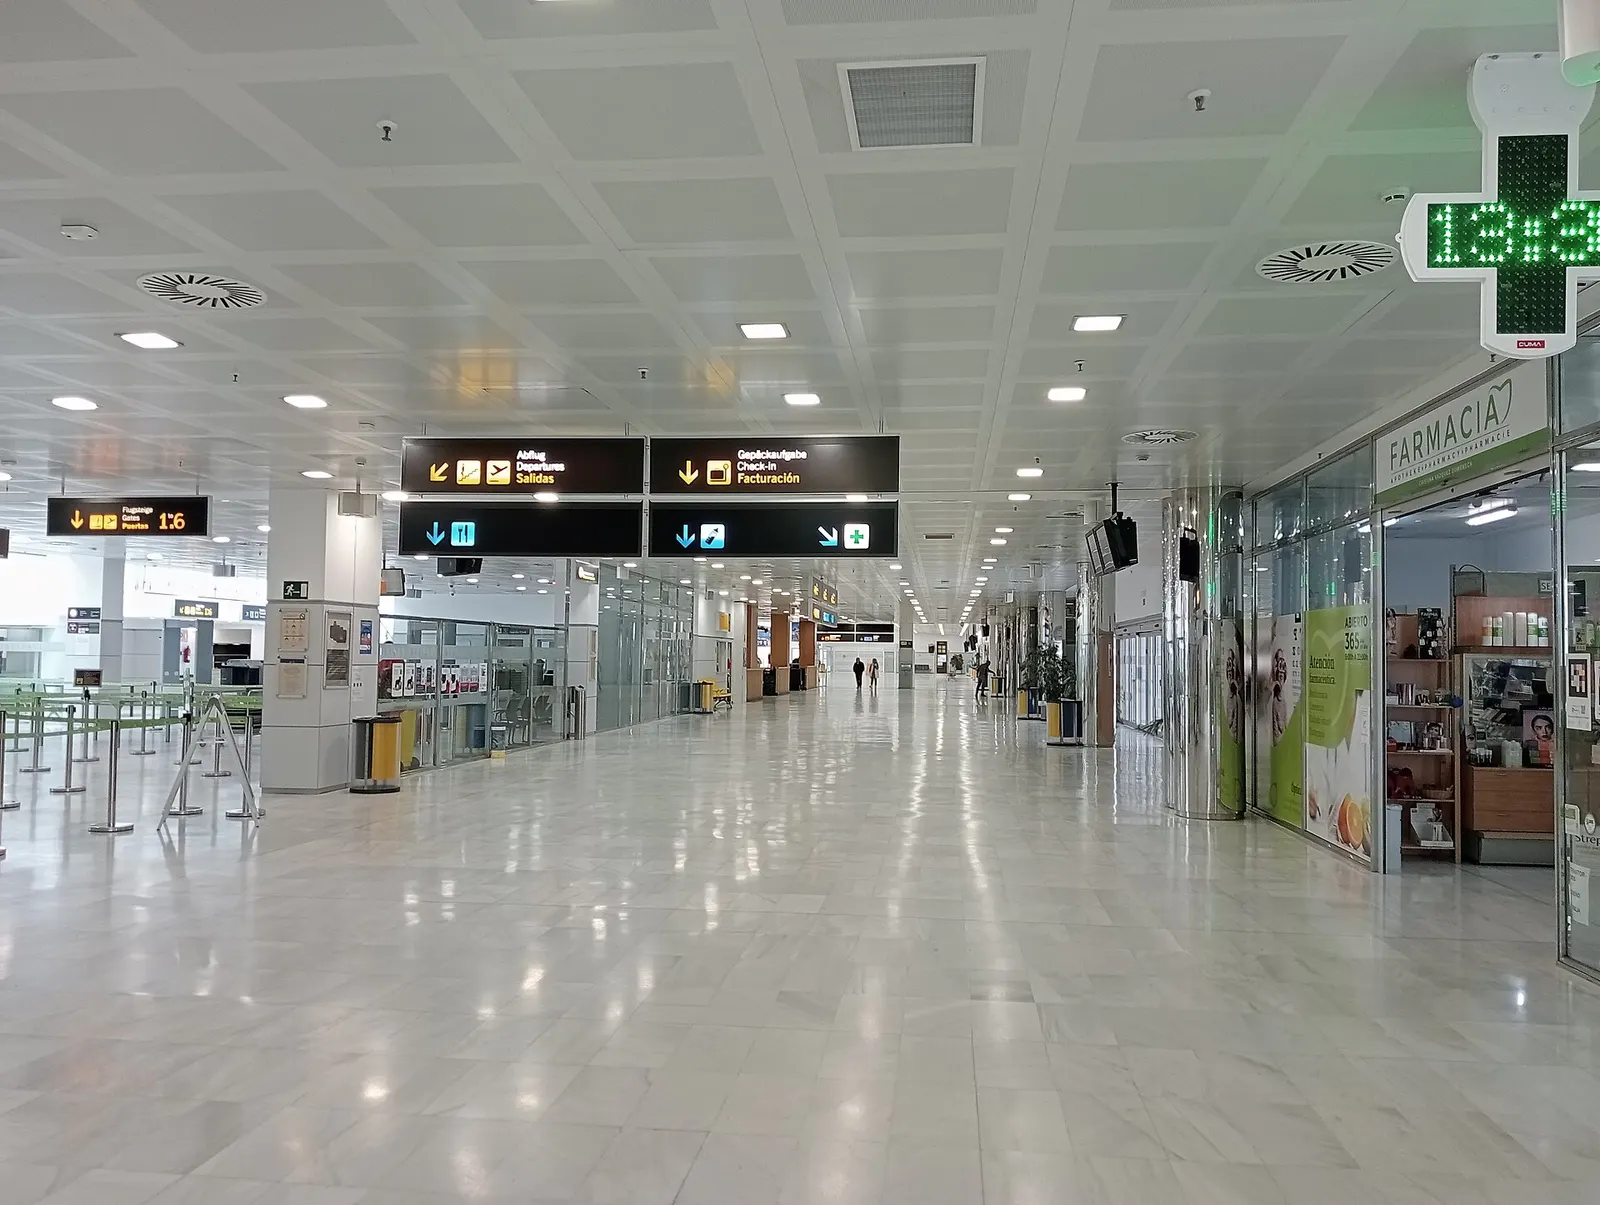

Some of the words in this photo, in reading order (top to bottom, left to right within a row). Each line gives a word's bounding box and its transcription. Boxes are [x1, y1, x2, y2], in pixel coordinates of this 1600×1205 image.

[1390, 394, 1500, 471] FARMACIA
[516, 450, 547, 462] Abflug
[737, 449, 807, 461] Gepäckaufgabe
[516, 462, 565, 473] Departures
[737, 461, 777, 471] Check-in
[516, 473, 555, 484] Salidas
[737, 472, 800, 484] Facturación
[122, 514, 140, 522] Gates
[122, 522, 149, 530] Puertas
[1344, 615, 1368, 628] ABIERTO
[1345, 632, 1359, 650] 365
[1309, 653, 1335, 669] Atención
